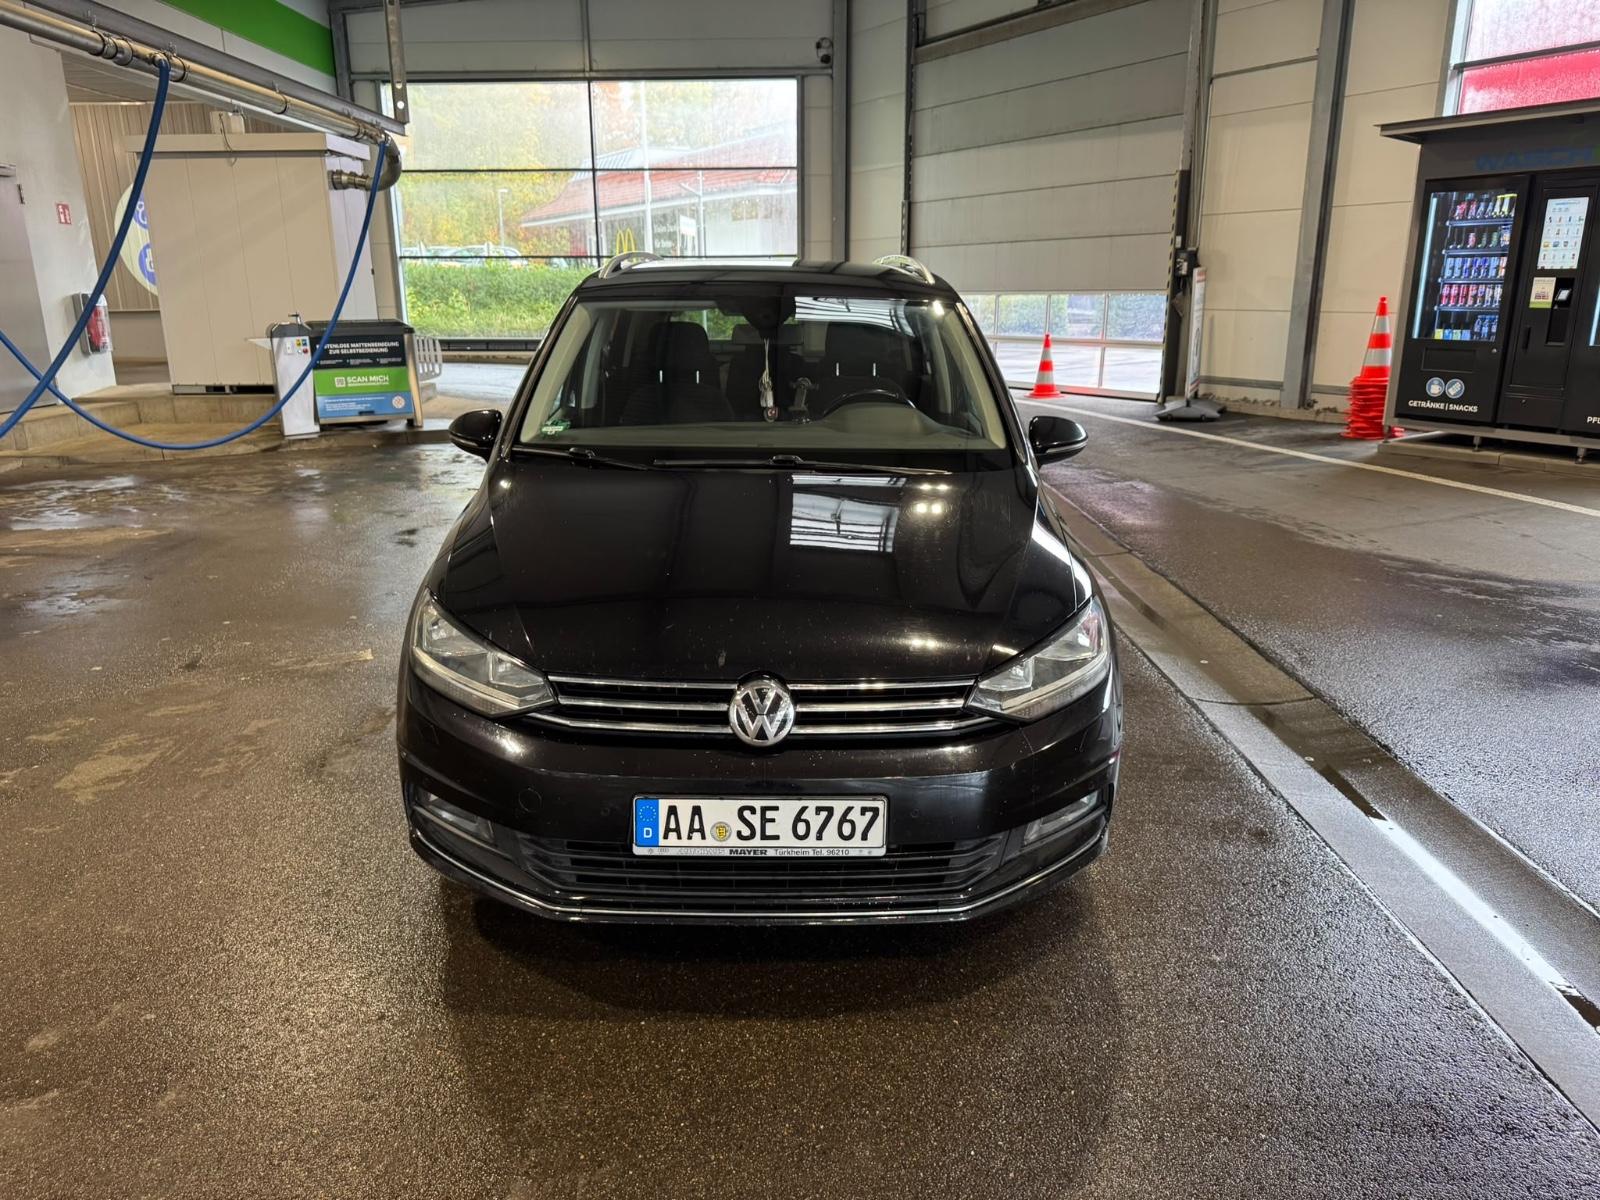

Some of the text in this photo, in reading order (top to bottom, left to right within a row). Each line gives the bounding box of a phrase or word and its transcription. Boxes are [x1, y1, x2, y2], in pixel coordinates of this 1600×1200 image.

[1475, 145, 1600, 170] WASCH
[369, 374, 389, 382] MICH
[1408, 400, 1445, 410] GETRÄNKE
[1449, 403, 1479, 413] SNACKS
[643, 804, 881, 842] D AA SE 6767
[729, 848, 768, 856] MAYER
[826, 848, 850, 856] 96210
